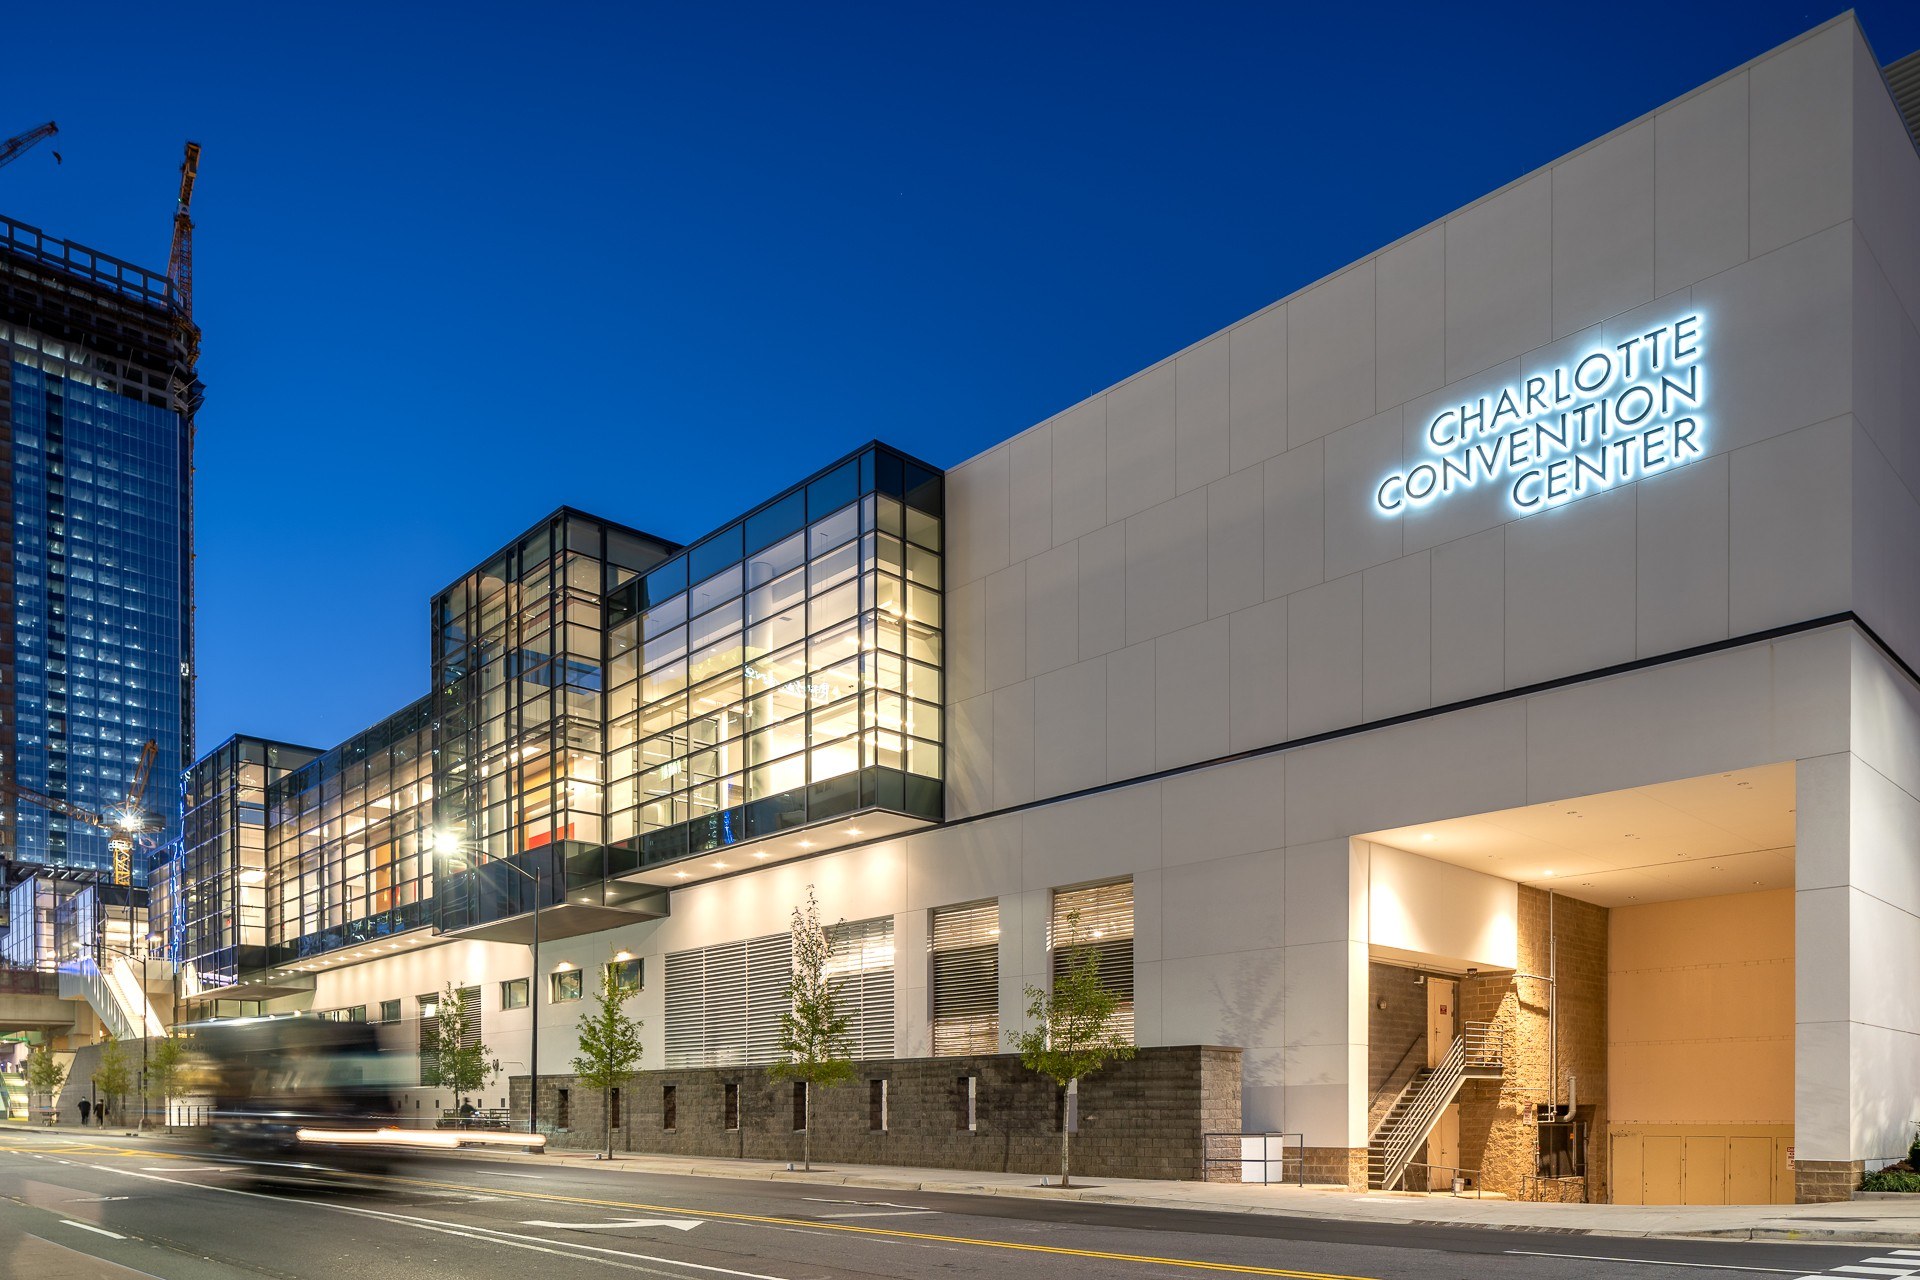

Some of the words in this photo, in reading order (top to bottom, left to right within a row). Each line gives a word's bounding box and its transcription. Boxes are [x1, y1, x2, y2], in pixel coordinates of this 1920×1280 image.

[1377, 365, 1697, 511] CONVENTION
[1429, 315, 1697, 446] CHARLOTTE
[1512, 417, 1699, 508] CENTER
